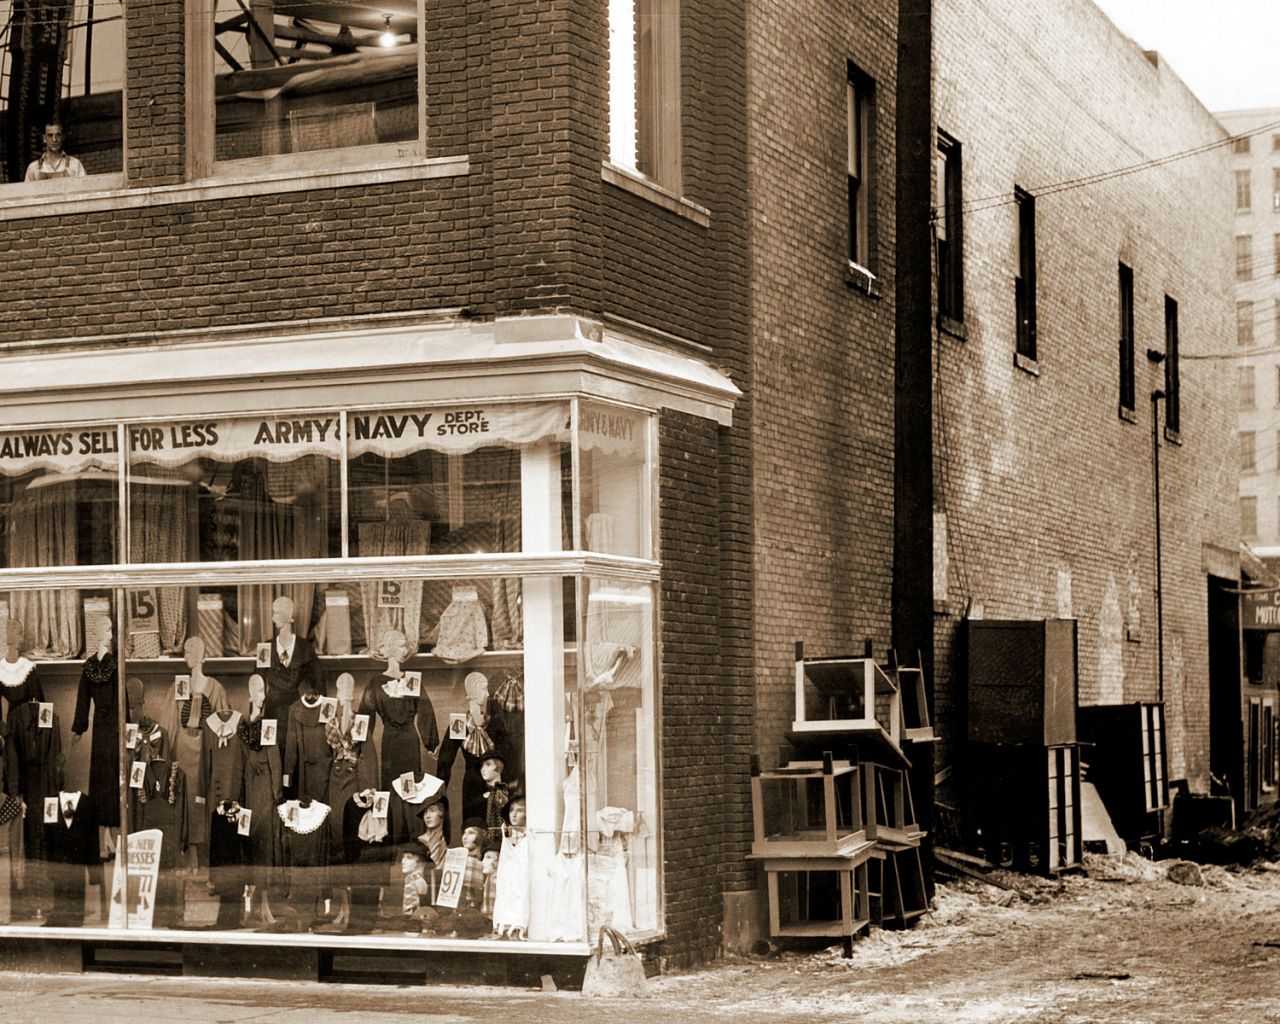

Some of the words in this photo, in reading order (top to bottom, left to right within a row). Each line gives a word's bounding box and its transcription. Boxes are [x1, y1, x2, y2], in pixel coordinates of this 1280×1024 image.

[253, 418, 333, 445] ARMY
[354, 413, 432, 440] NAVY
[436, 421, 491, 437] STORE
[444, 409, 486, 424] DEPT.
[0, 432, 74, 459] ALWAYS
[130, 427, 164, 451] FOR
[171, 422, 219, 449] LESS
[441, 869, 461, 895] 97
